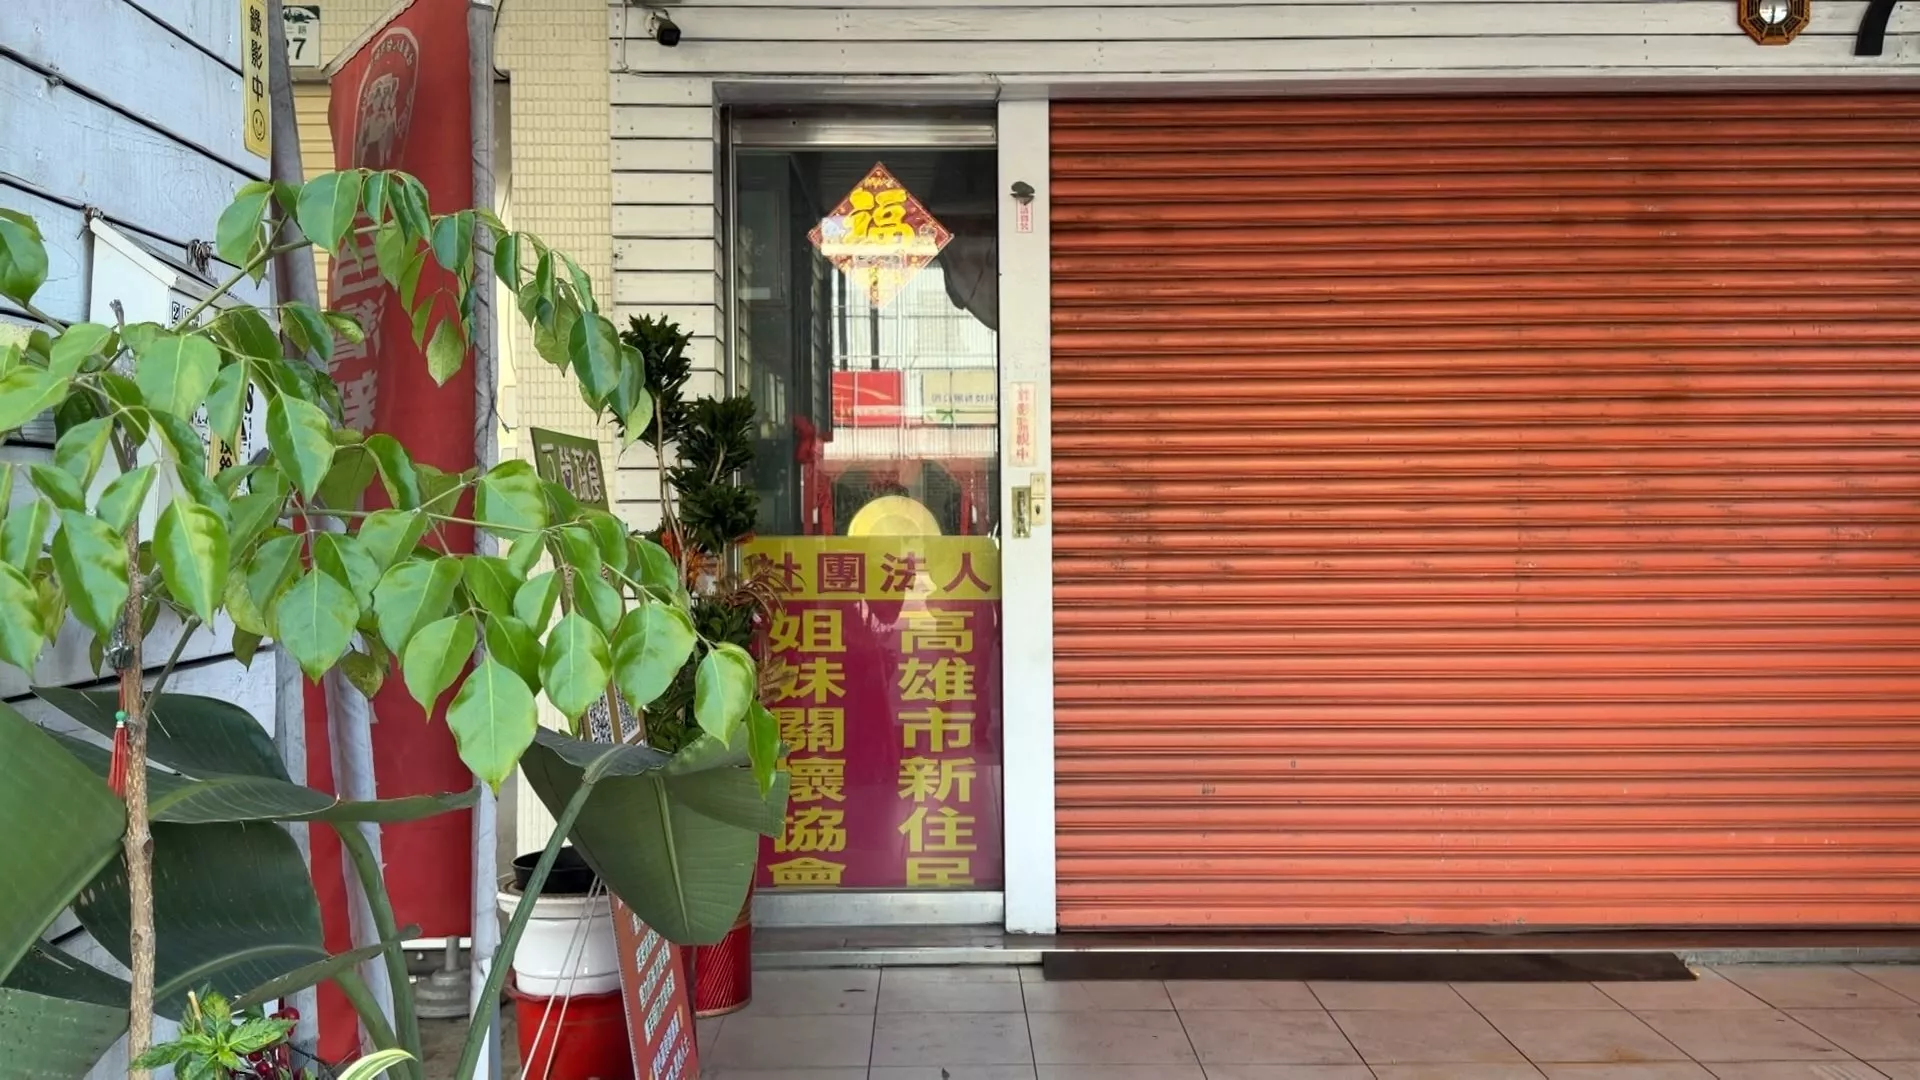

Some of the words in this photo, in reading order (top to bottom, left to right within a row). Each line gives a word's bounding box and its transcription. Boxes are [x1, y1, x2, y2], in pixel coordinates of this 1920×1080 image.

[249, 5, 264, 103] 錄影中
[286, 37, 307, 60] 7
[842, 186, 916, 247] 福
[748, 551, 992, 594] 社團法人
[768, 608, 847, 888] 姐妹關懷協會
[898, 609, 977, 887] 高雄市新住民
